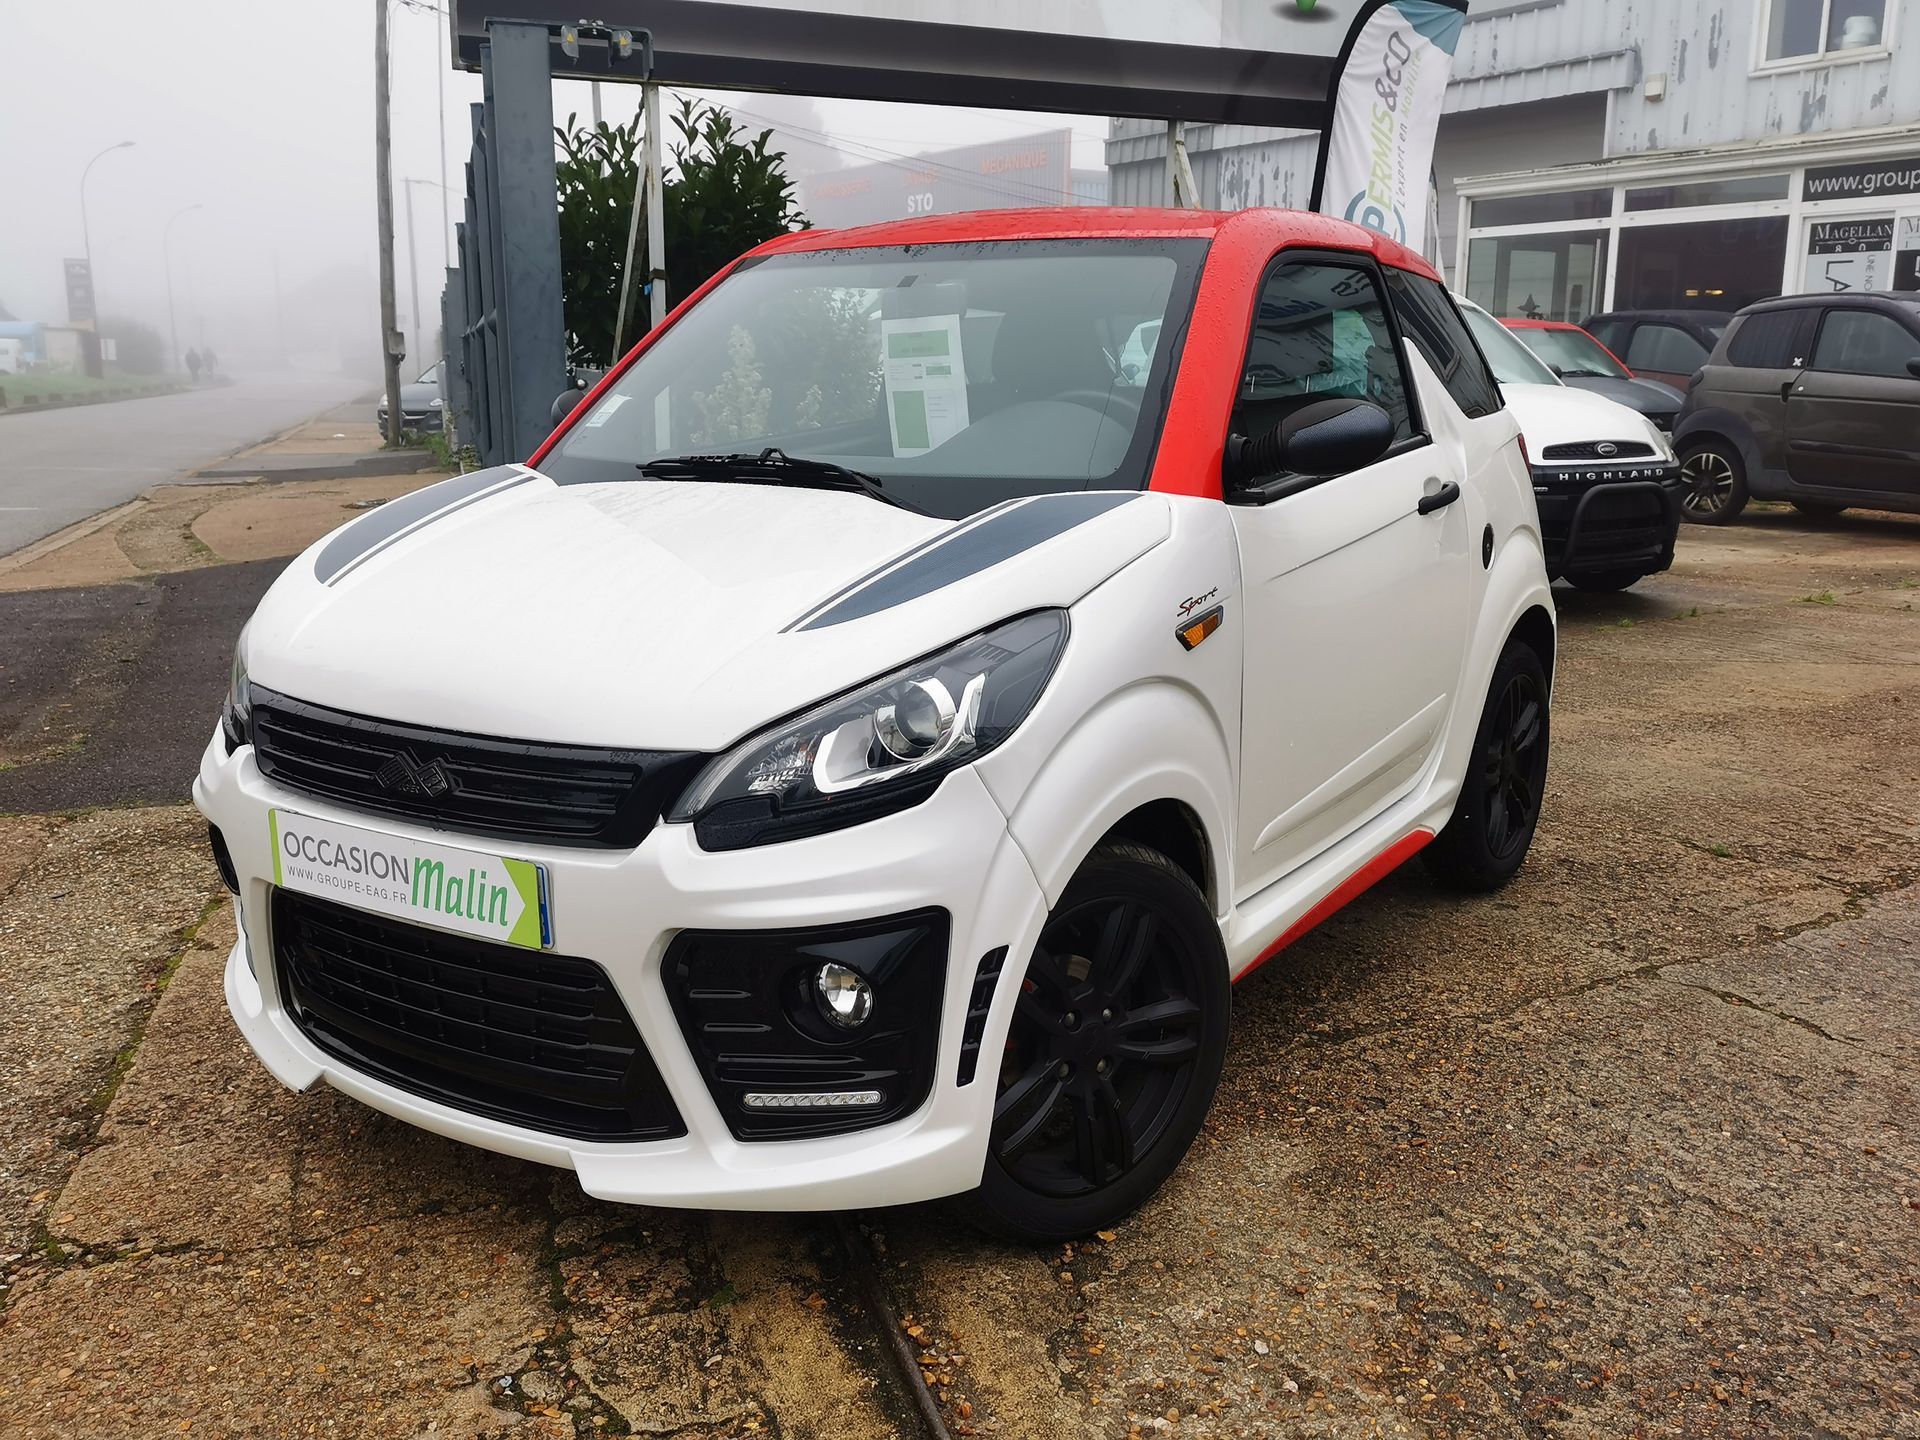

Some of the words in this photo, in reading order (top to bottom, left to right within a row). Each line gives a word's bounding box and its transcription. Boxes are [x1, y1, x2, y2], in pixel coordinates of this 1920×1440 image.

[1815, 224, 1893, 240] MAGELLAN
[1559, 469, 1663, 481] HIGHLAND
[1177, 586, 1218, 617] Sport
[283, 831, 410, 884] OCCASION
[411, 857, 508, 926] Malin
[286, 865, 408, 904] WWW.GROUPE-EAG.FR
